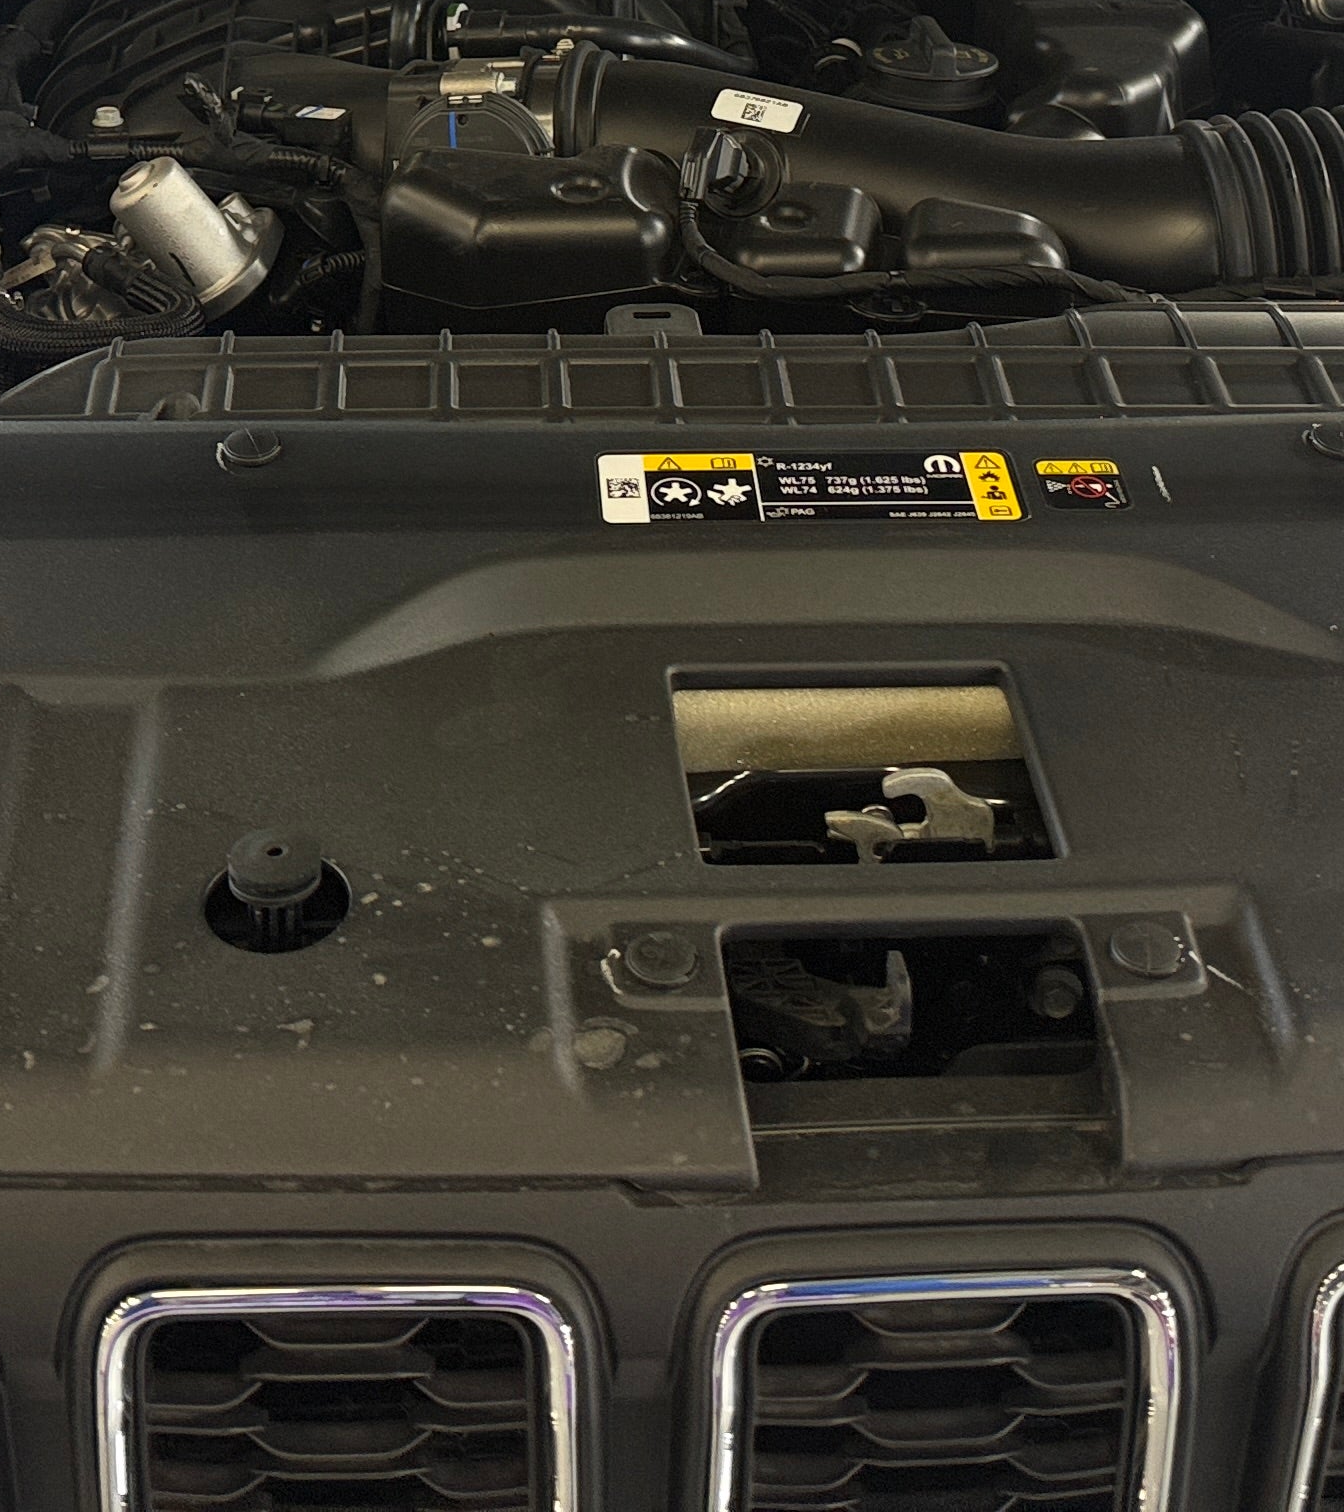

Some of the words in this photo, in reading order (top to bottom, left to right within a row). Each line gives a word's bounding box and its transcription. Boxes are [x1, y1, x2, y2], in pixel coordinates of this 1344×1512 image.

[776, 462, 833, 472] R-1234yf
[778, 476, 817, 485] WL75
[825, 476, 858, 486] 737g
[859, 476, 899, 486] (1.625
[900, 476, 926, 485] lbs)
[780, 486, 818, 495] WL74
[827, 486, 860, 496] 624g
[862, 486, 902, 496] (1.375
[903, 486, 929, 495] lbs)
